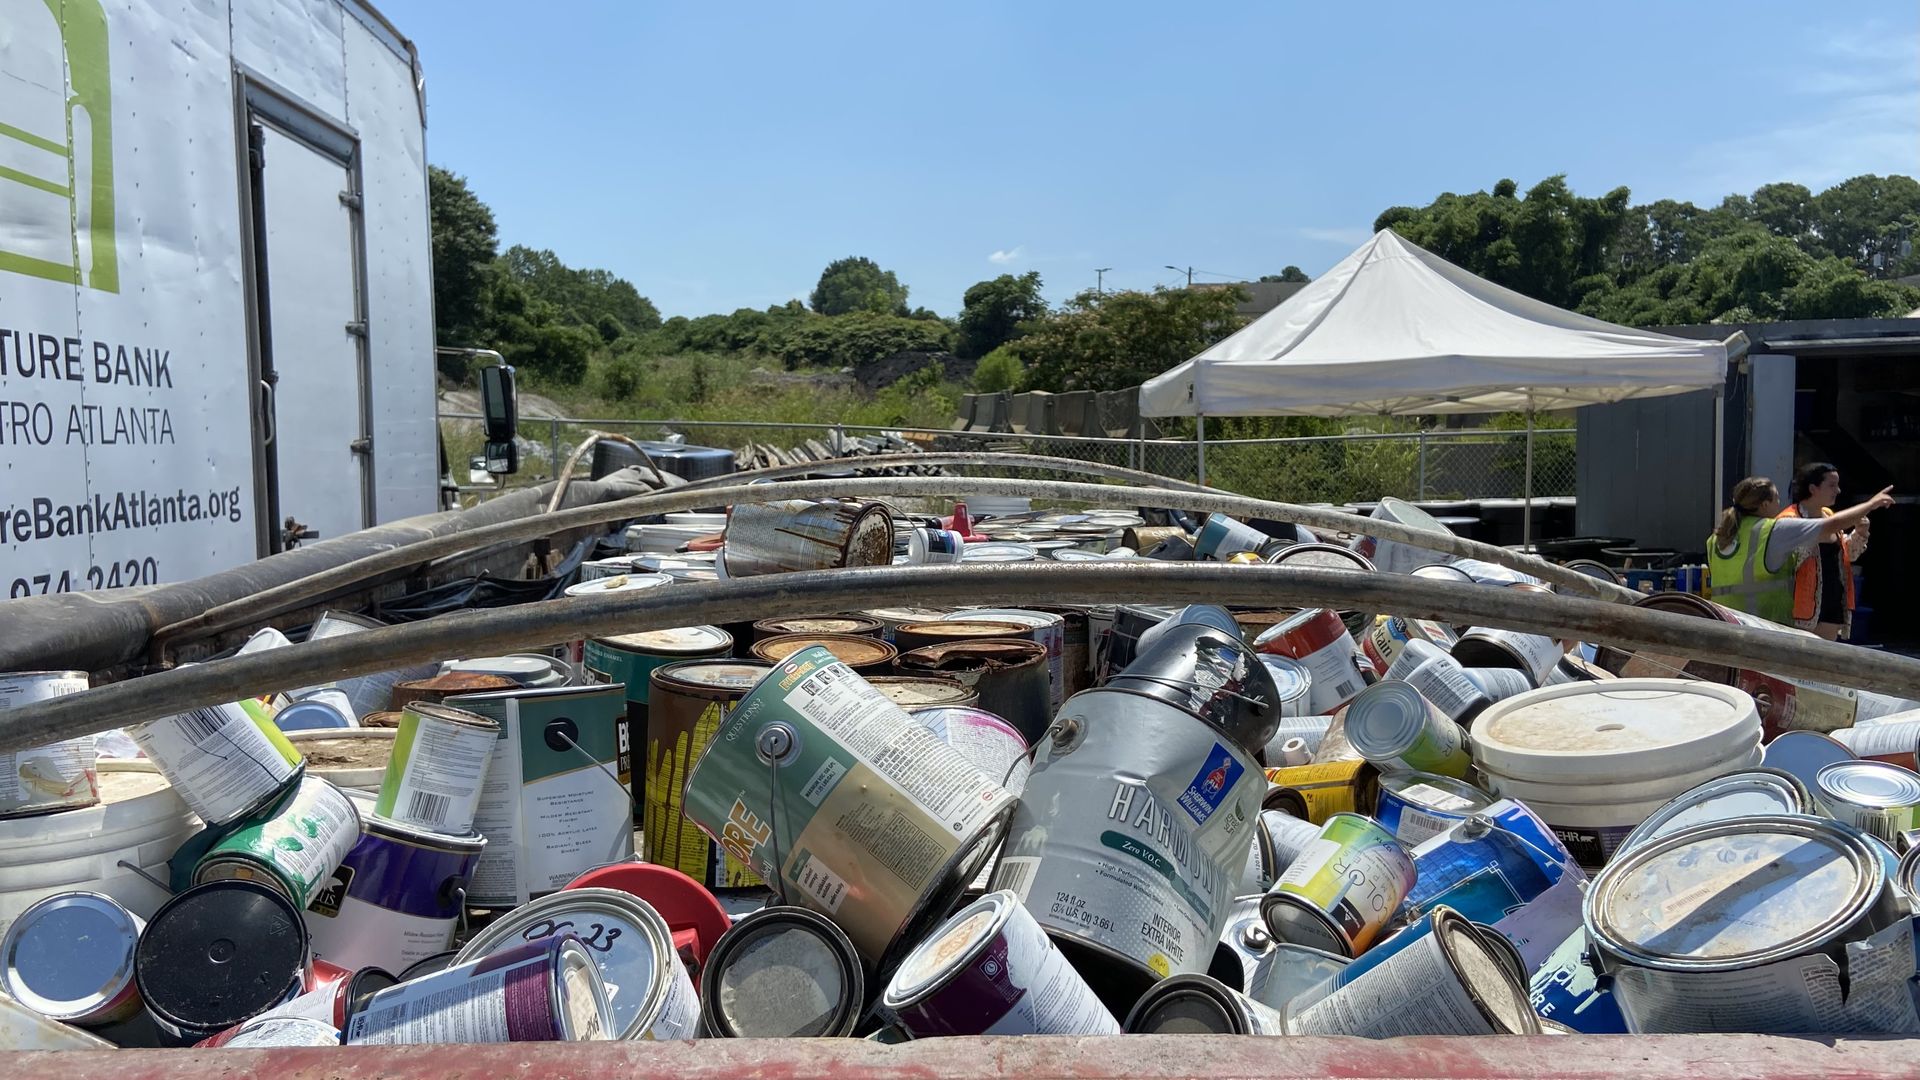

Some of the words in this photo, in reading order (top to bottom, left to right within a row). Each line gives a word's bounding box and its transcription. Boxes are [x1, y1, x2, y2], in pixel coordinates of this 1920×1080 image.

[93, 341, 173, 388] BANK
[66, 404, 175, 445] ATLANTA
[87, 557, 158, 591] 2420
[1179, 792, 1208, 825] WILLIAMS
[1187, 785, 1215, 814] SHERWIN
[1122, 840, 1140, 855] Zero
[1056, 891, 1069, 903] 124
[1093, 916, 1110, 929] 3.66
[1152, 912, 1182, 942] INTERIOR
[1141, 922, 1165, 948] EXTRA
[1165, 936, 1185, 962] WHITE
